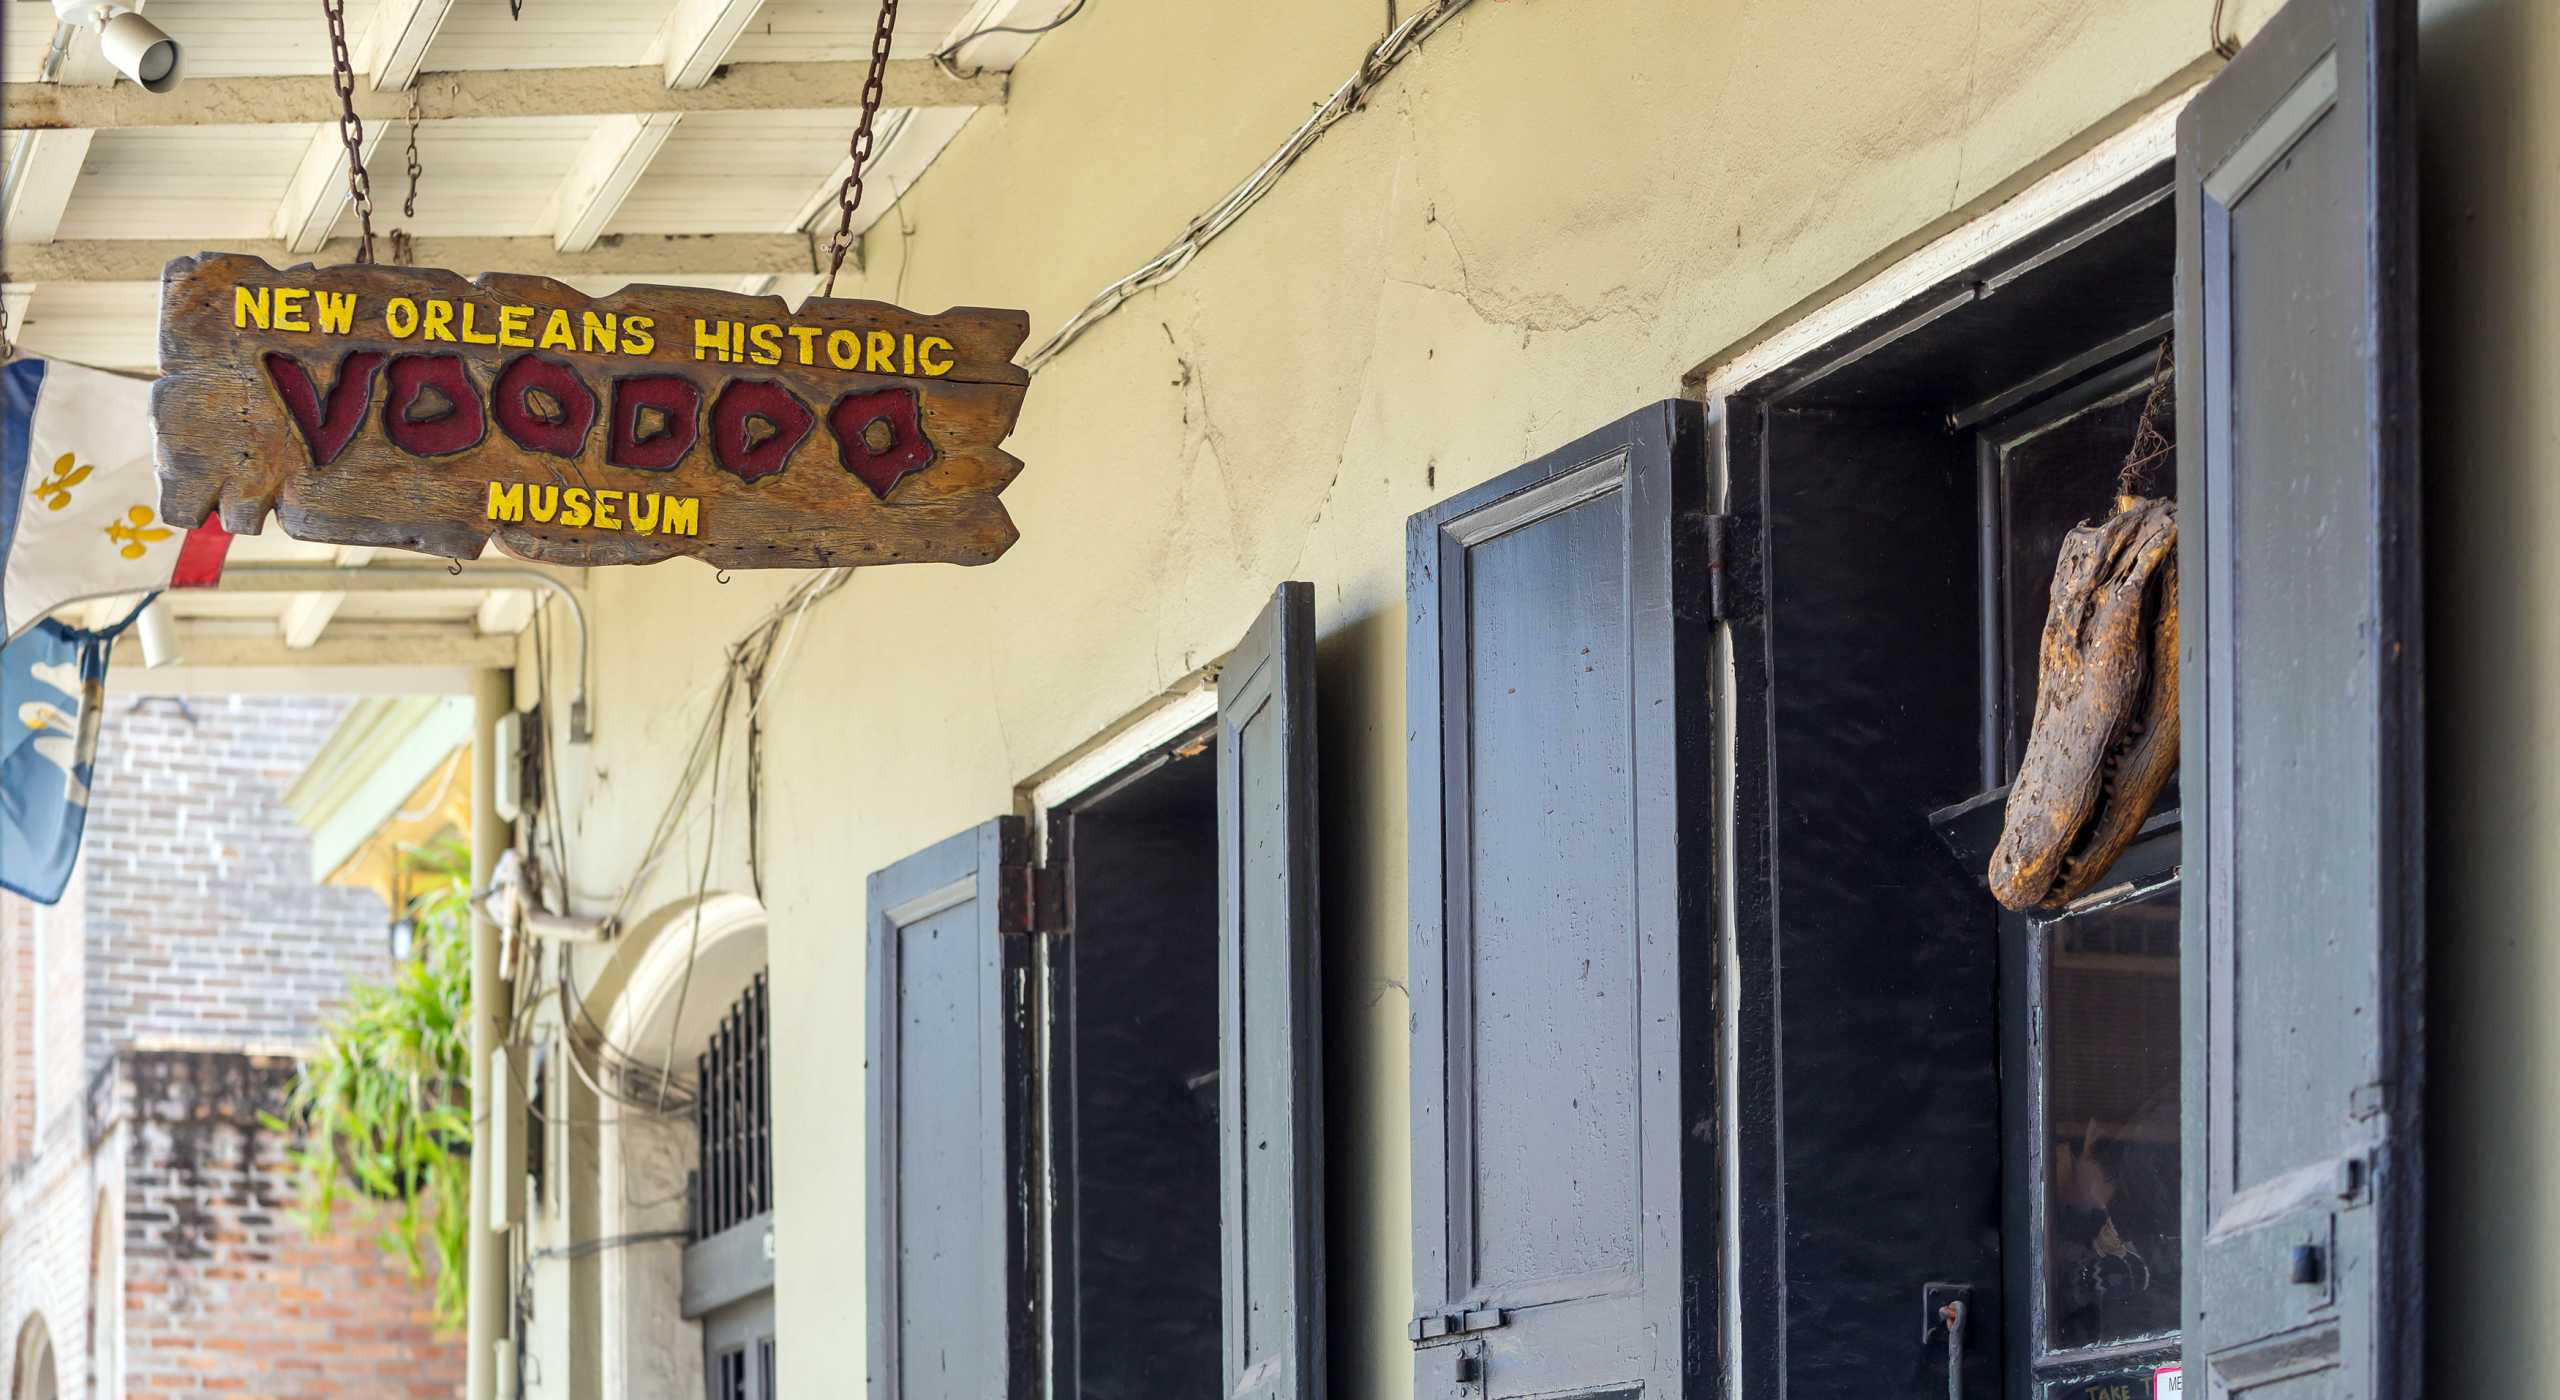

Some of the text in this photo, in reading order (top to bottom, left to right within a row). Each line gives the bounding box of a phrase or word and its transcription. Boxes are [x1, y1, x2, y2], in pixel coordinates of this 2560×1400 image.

[236, 287, 954, 376] NEW ORLEANS HISTORIC
[262, 351, 939, 500] VOODOO
[488, 482, 700, 536] MUSEUM
